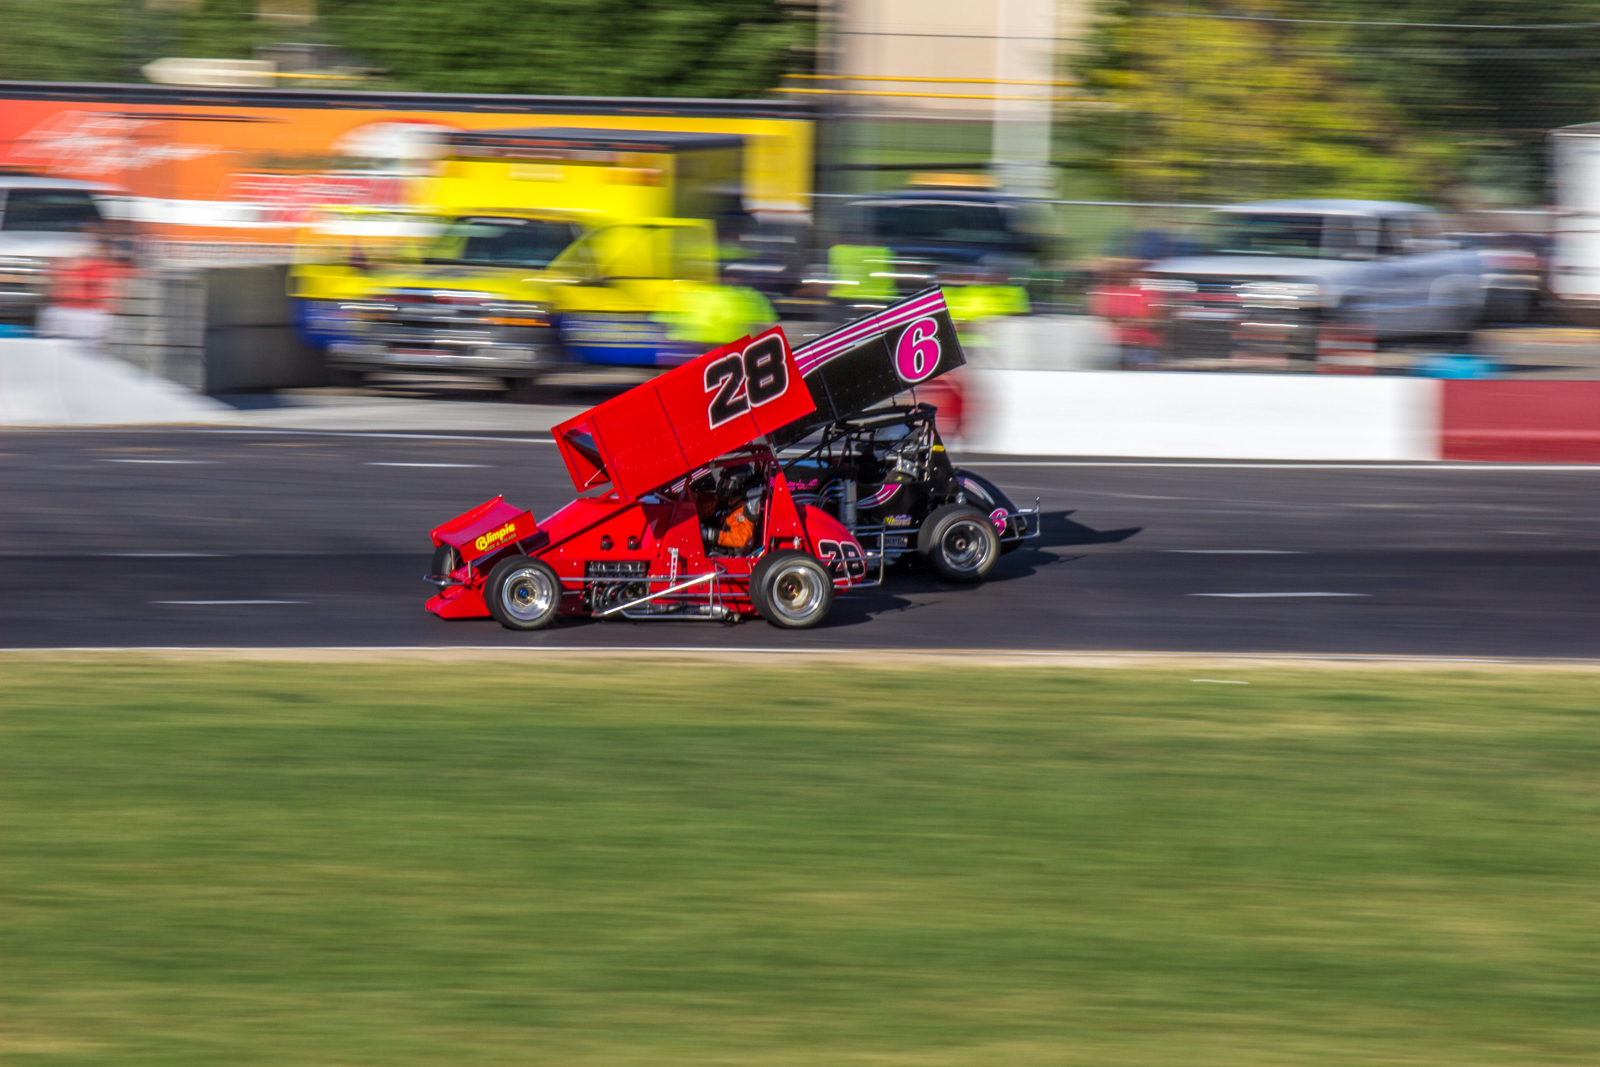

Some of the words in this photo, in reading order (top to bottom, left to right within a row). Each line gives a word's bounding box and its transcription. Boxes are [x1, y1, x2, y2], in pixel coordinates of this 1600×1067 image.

[895, 316, 942, 384] 6
[703, 332, 789, 430] 28
[475, 523, 515, 551] Blimpie
[988, 507, 1009, 537] 6
[818, 539, 866, 583] 28
